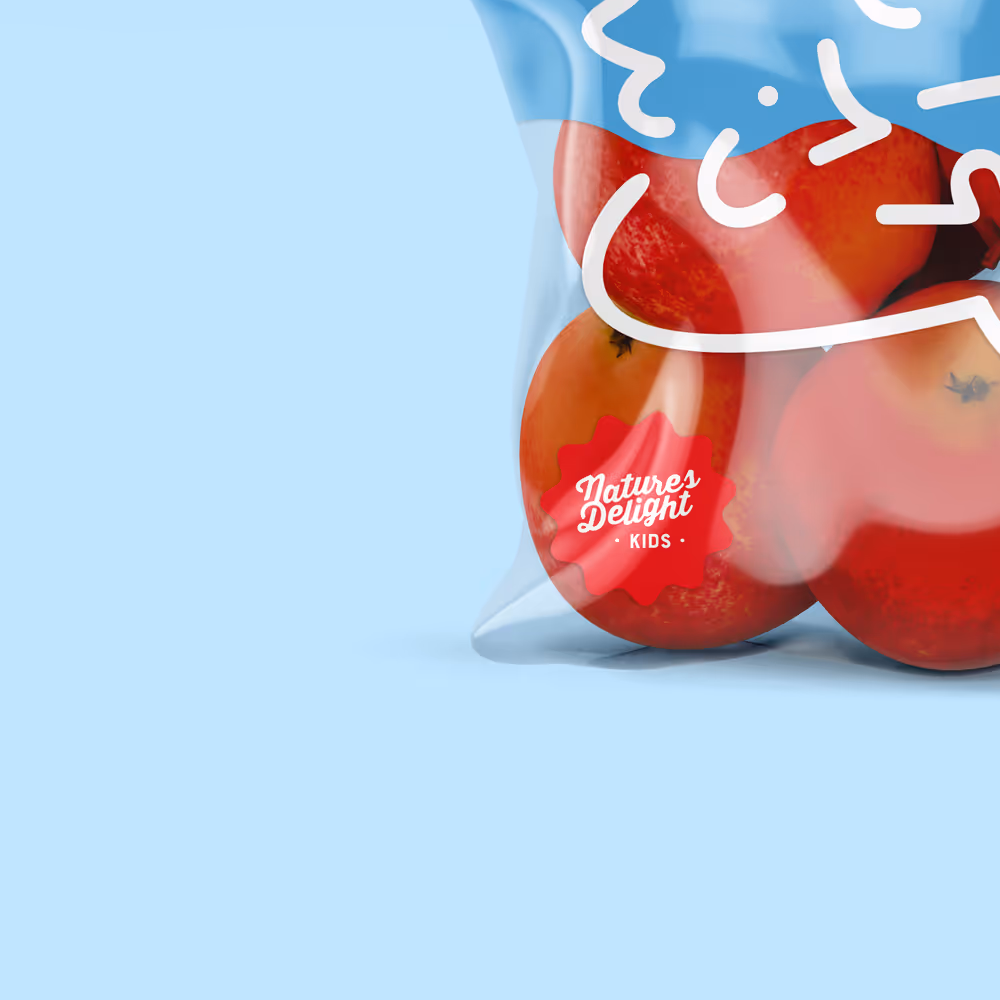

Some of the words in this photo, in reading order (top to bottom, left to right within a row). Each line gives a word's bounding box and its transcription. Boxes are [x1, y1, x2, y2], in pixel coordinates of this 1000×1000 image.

[575, 469, 701, 504] Natures
[577, 490, 693, 534] Delight
[629, 533, 672, 549] KIDS
